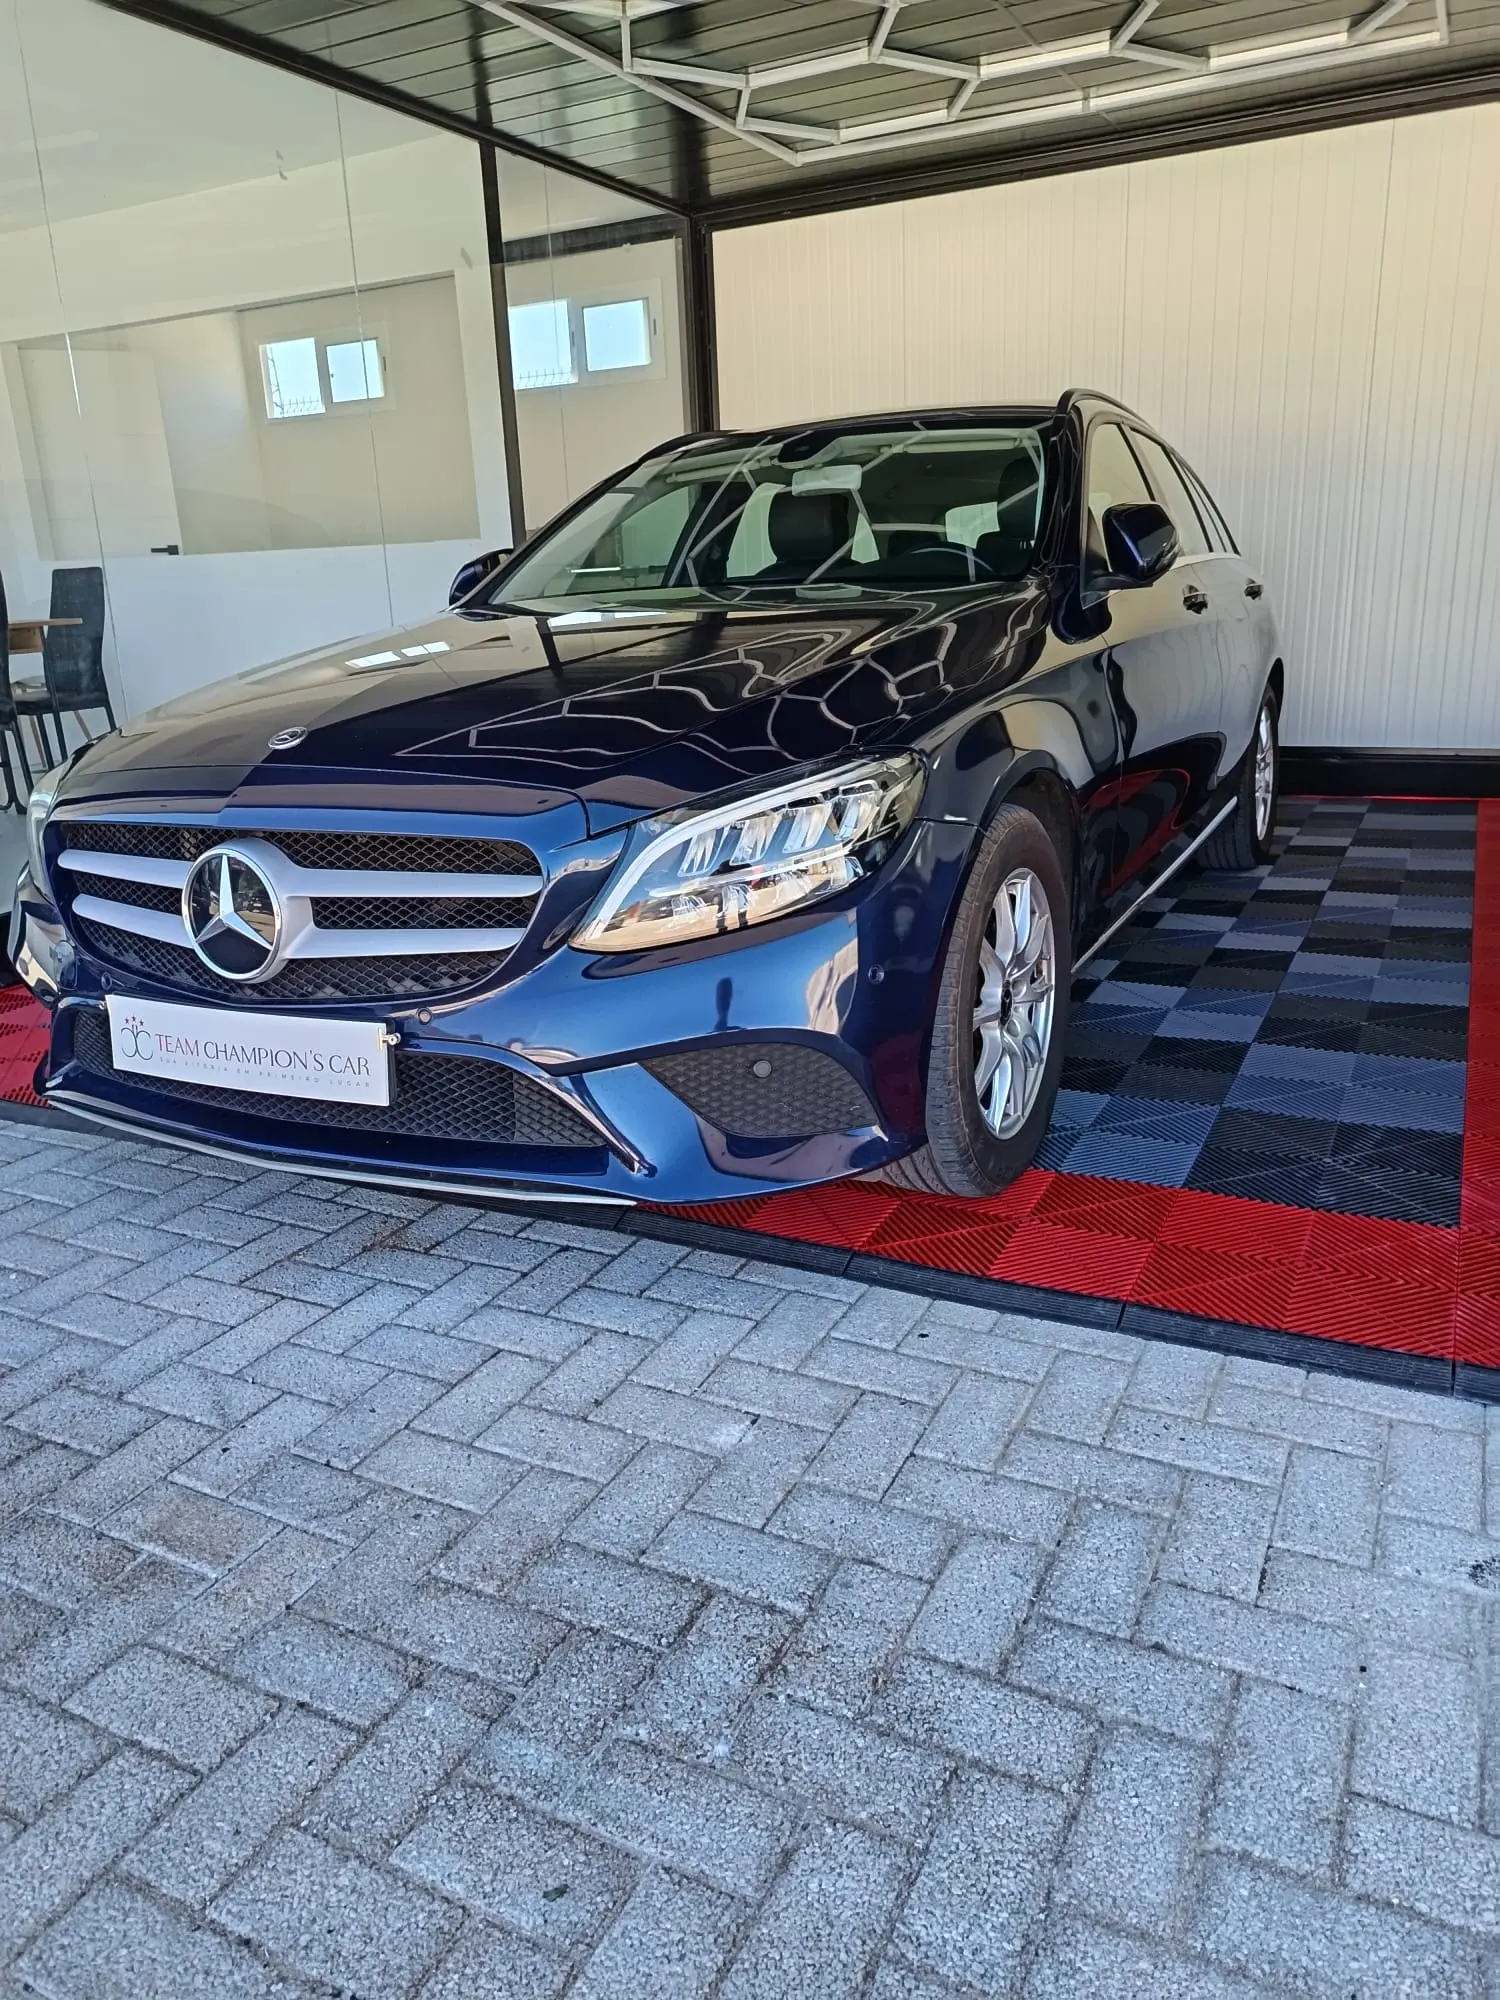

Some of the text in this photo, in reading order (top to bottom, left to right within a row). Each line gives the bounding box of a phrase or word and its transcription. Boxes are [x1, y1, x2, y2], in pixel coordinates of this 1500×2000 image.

[155, 1033, 200, 1057] TEAM
[203, 1040, 324, 1072] CHAMPION'S
[328, 1054, 370, 1076] CAR
